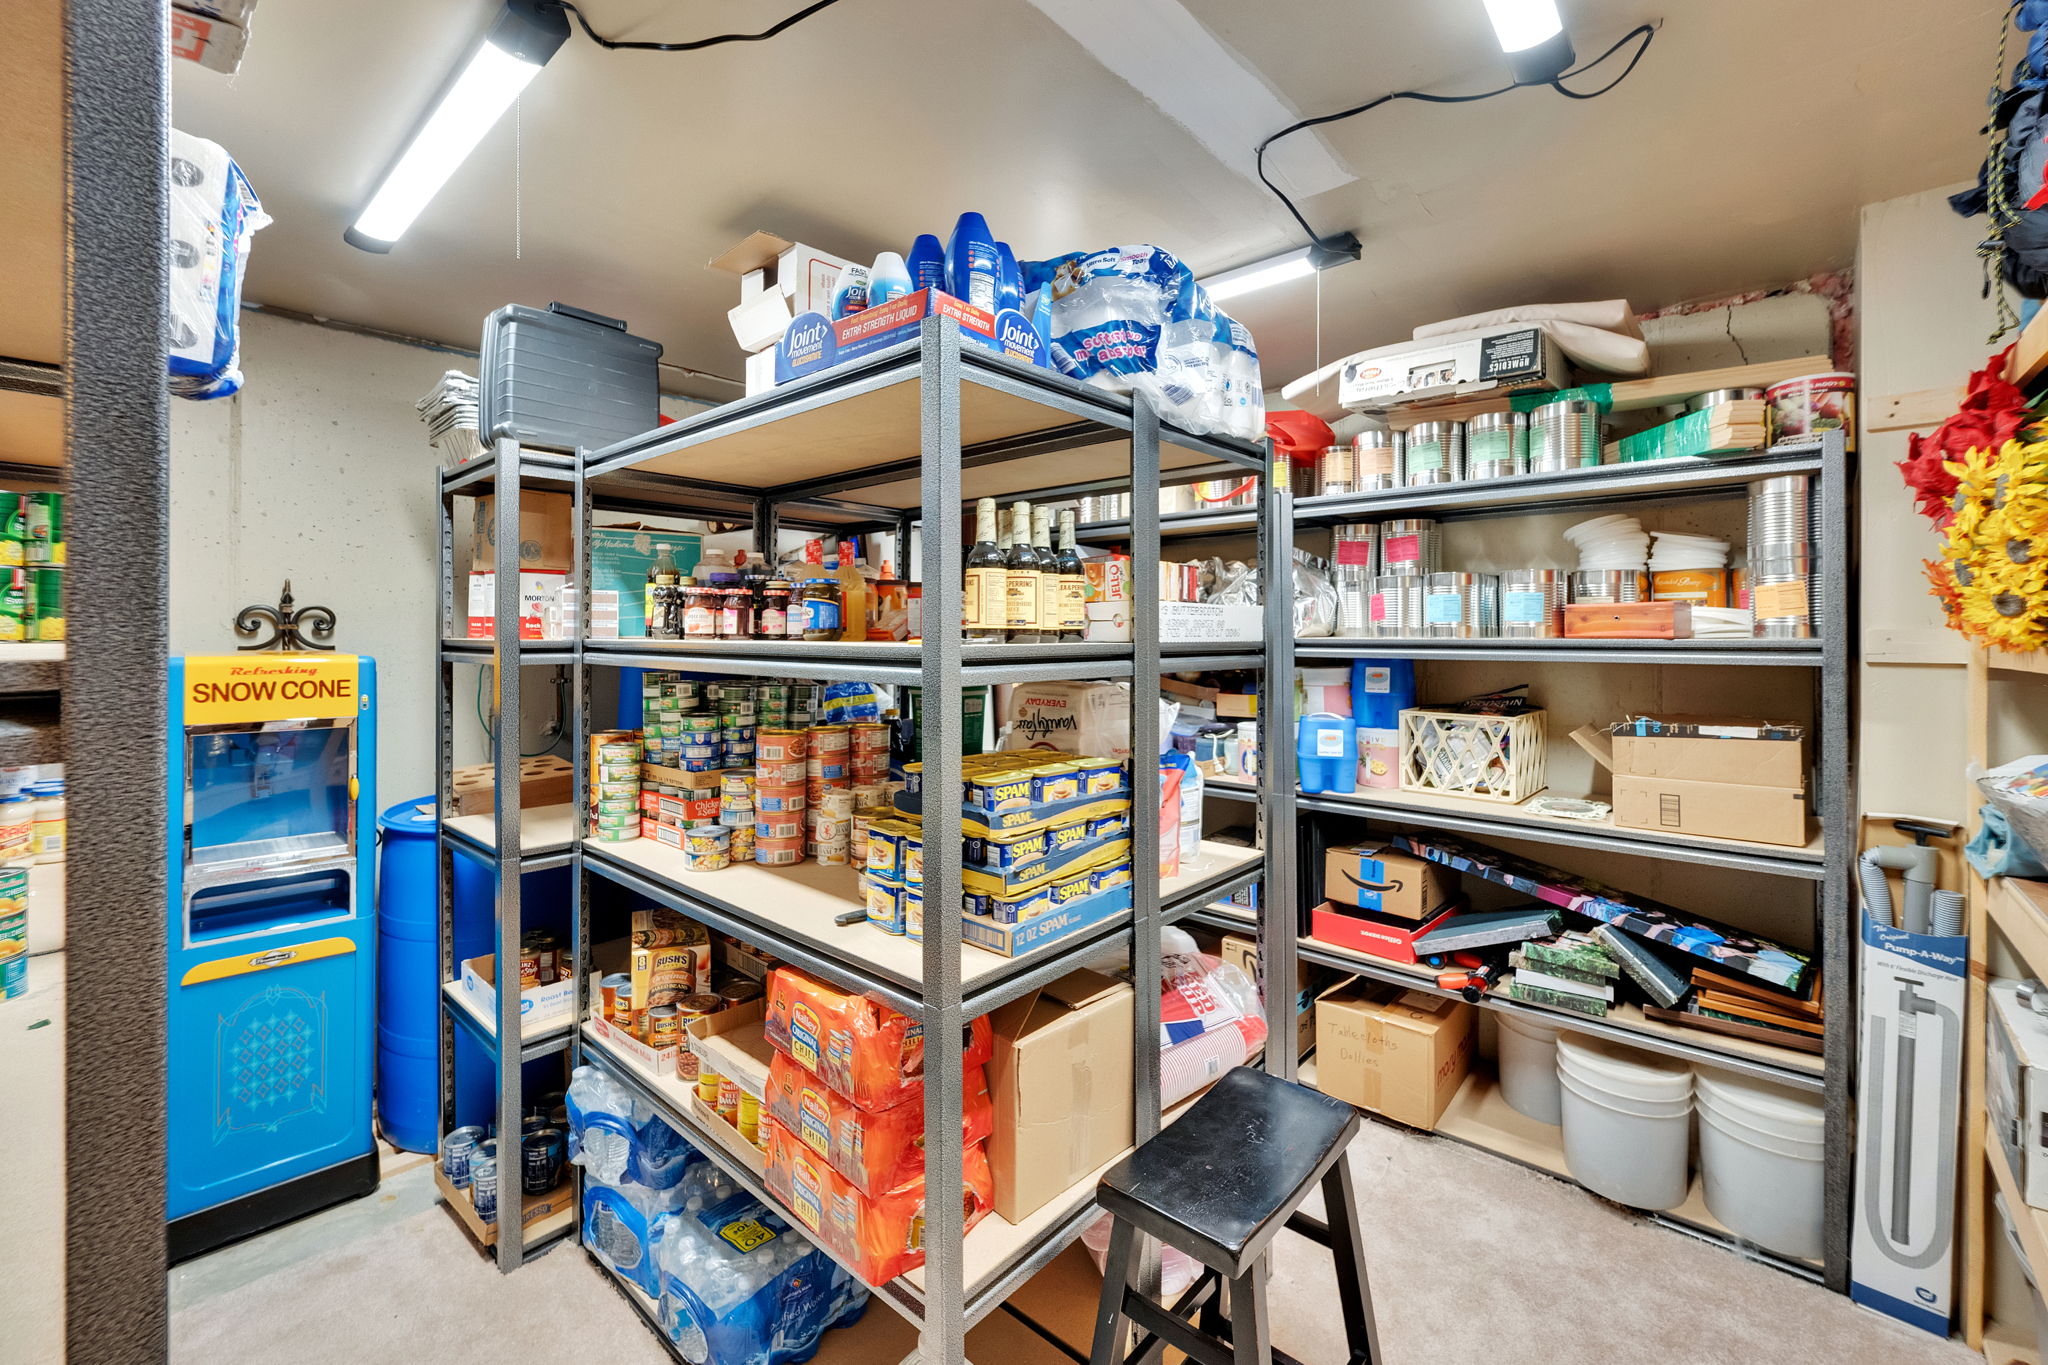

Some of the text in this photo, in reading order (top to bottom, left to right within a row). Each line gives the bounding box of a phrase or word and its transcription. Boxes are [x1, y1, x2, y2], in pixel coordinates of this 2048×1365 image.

[1102, 256, 1116, 264] Soft
[862, 312, 894, 335] STRENGTH
[895, 305, 918, 324] LIQUID
[961, 312, 990, 332] STRENGTH
[787, 324, 823, 357] Joint
[1000, 319, 1034, 350] Joint
[790, 341, 823, 359] movement
[1004, 339, 1035, 358] movement
[1487, 358, 1530, 373] HOMEDICS
[1111, 563, 1122, 600] JELL-O
[524, 594, 555, 602] MORTON
[230, 666, 318, 676] Refreshing
[192, 679, 352, 703] SNOW CONE
[1025, 697, 1067, 708] EVERYDAY
[994, 781, 1031, 801] SPAM
[695, 799, 721, 810] Chicke
[1002, 811, 1032, 828] SPAM
[1056, 825, 1086, 844] SPAM
[1012, 837, 1044, 858] SPAM
[1018, 864, 1045, 881] SPAM
[1059, 878, 1089, 900] SPAM
[1016, 932, 1025, 947] 12
[1026, 927, 1038, 942] OZ
[1038, 914, 1068, 937] SPAM
[656, 954, 688, 968] BUSH'S
[1884, 942, 1957, 965] Pump-A-Way
[541, 993, 562, 1002] Roast
[656, 1020, 677, 1030] BUSH'S
[794, 1008, 818, 1034] Nalley
[792, 1024, 819, 1051] ORIGINAL
[1328, 1022, 1399, 1051] Tablecloths
[794, 1040, 816, 1064] CHILI
[804, 1096, 828, 1121] Nalley
[801, 1110, 829, 1139] ORIGINAL
[803, 1125, 827, 1150] CHILI
[796, 1164, 820, 1192] Nalley
[793, 1178, 821, 1209] ORIGINAL
[794, 1196, 819, 1221] CHILI
